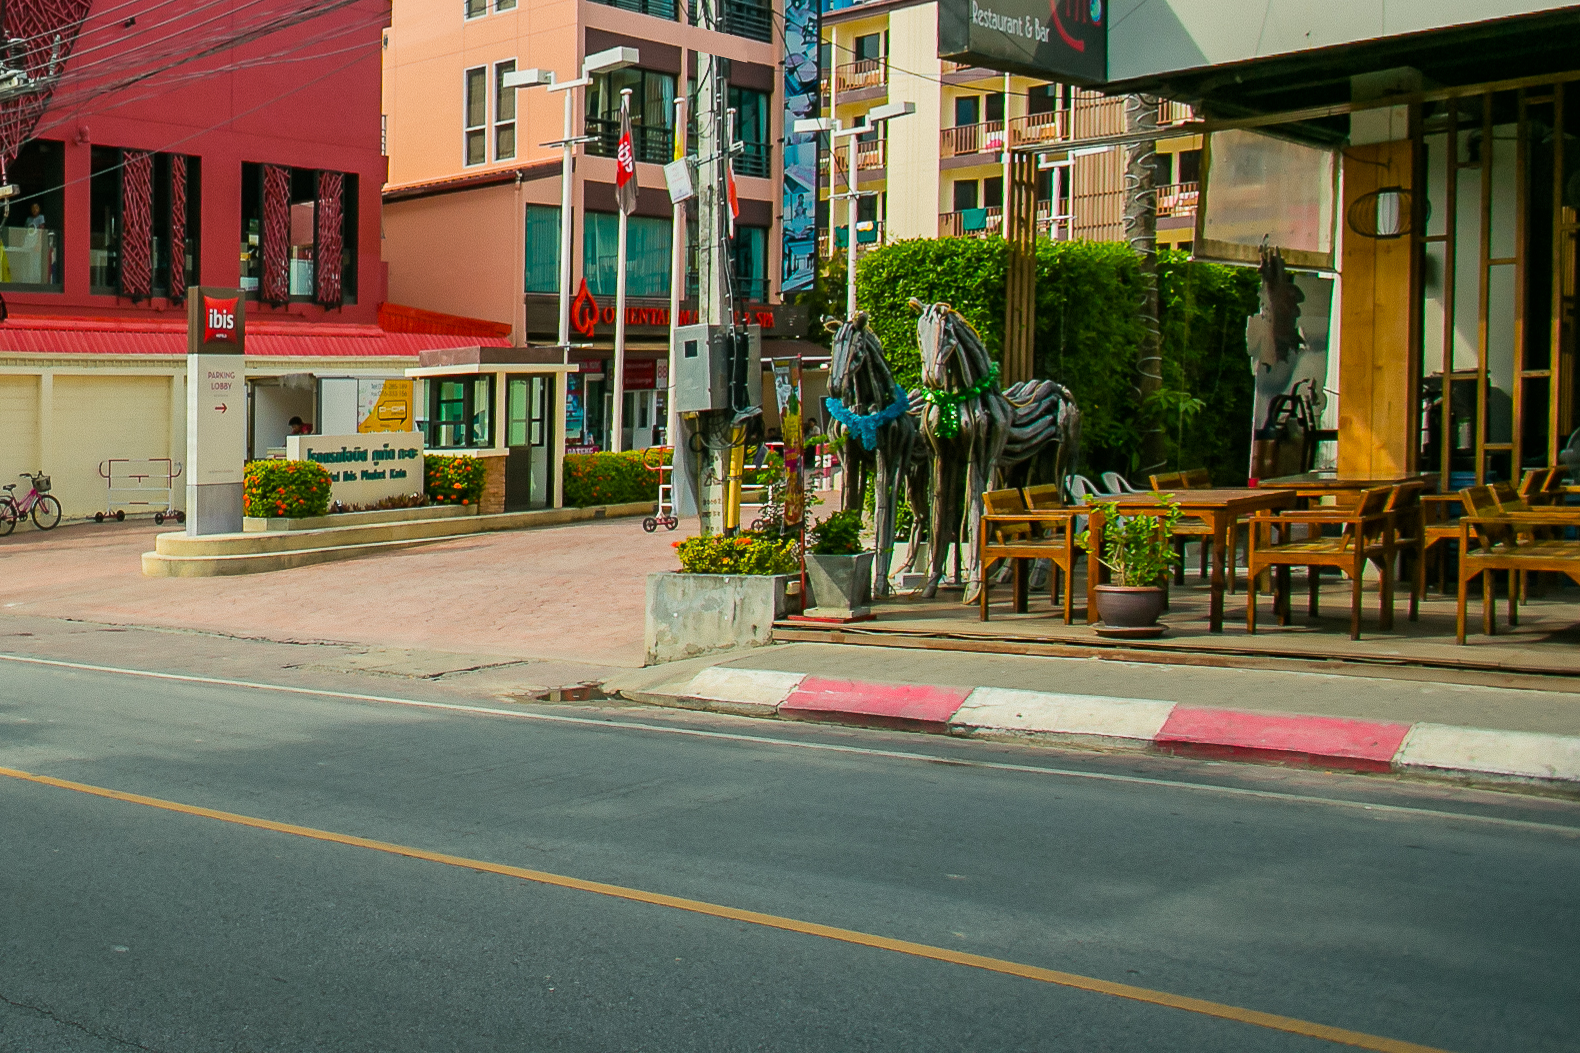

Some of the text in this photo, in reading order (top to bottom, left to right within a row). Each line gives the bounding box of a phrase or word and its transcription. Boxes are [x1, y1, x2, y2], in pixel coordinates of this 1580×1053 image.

[972, 0, 1050, 43] Restaurant & Bar
[209, 308, 234, 330] ibis
[602, 306, 670, 325] OIENTA
[755, 311, 775, 328] SPA
[207, 371, 235, 379] PARKING
[211, 382, 232, 390] LOBBY
